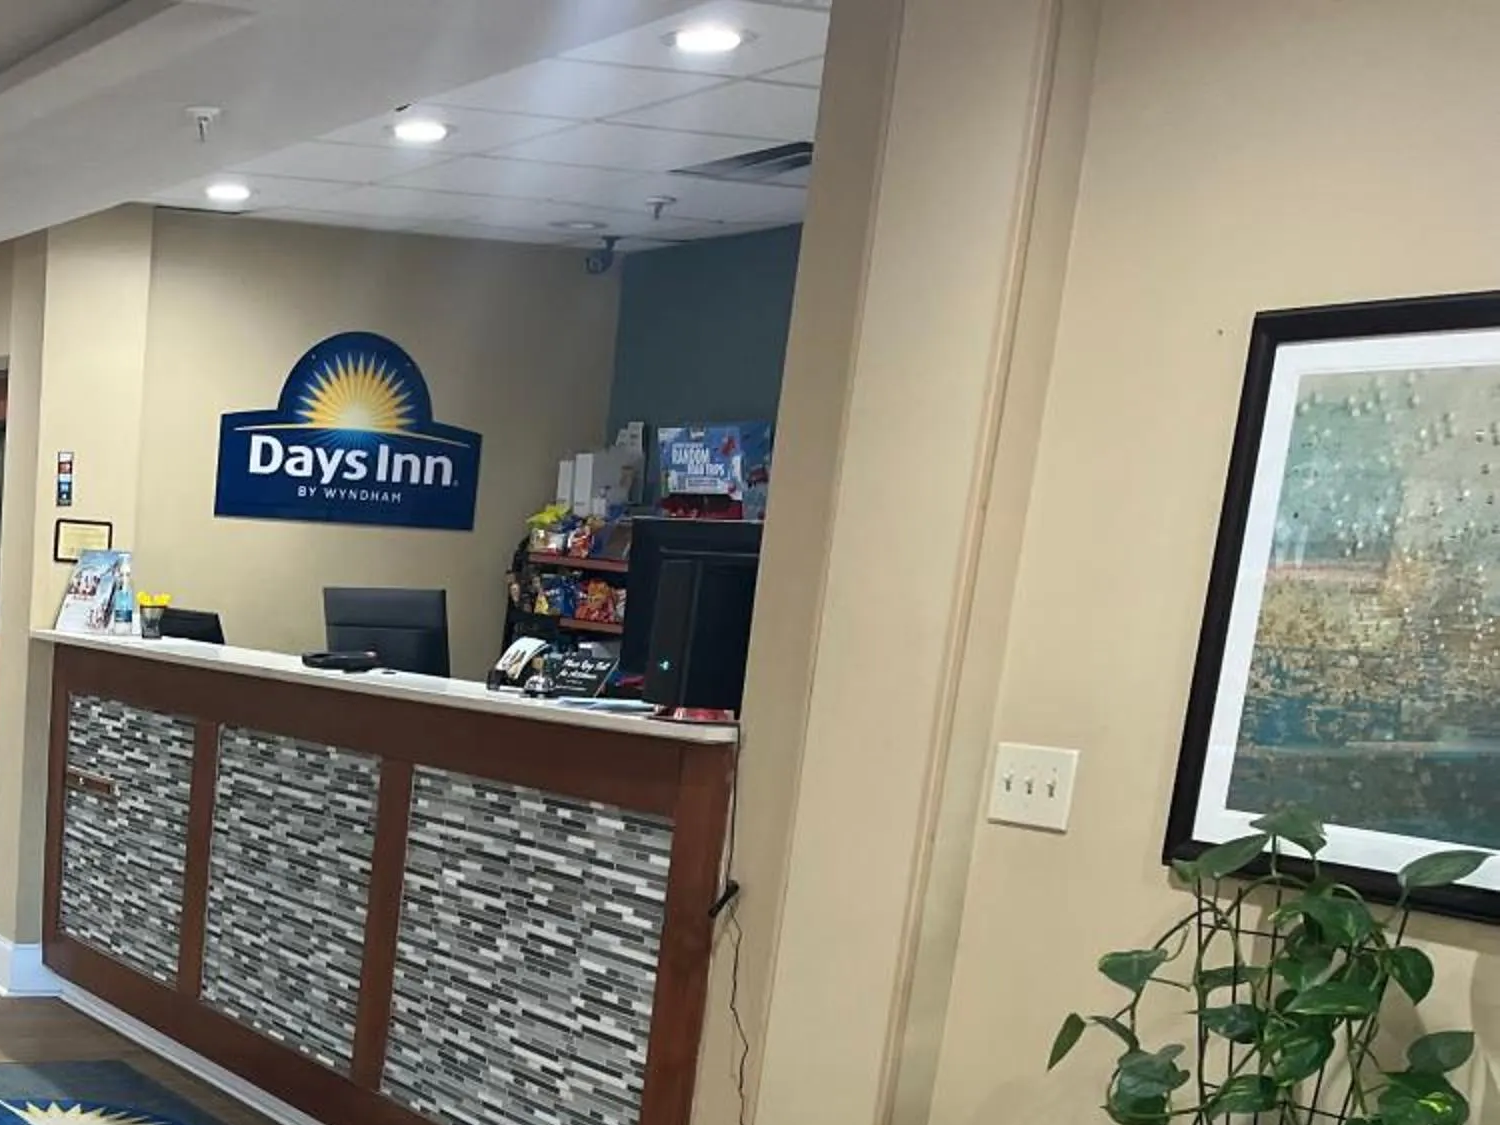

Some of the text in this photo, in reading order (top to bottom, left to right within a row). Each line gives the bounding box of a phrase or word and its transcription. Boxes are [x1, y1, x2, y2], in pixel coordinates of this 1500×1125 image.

[249, 433, 454, 487] Days Inn
[297, 485, 402, 504] BY WYNDHAM
